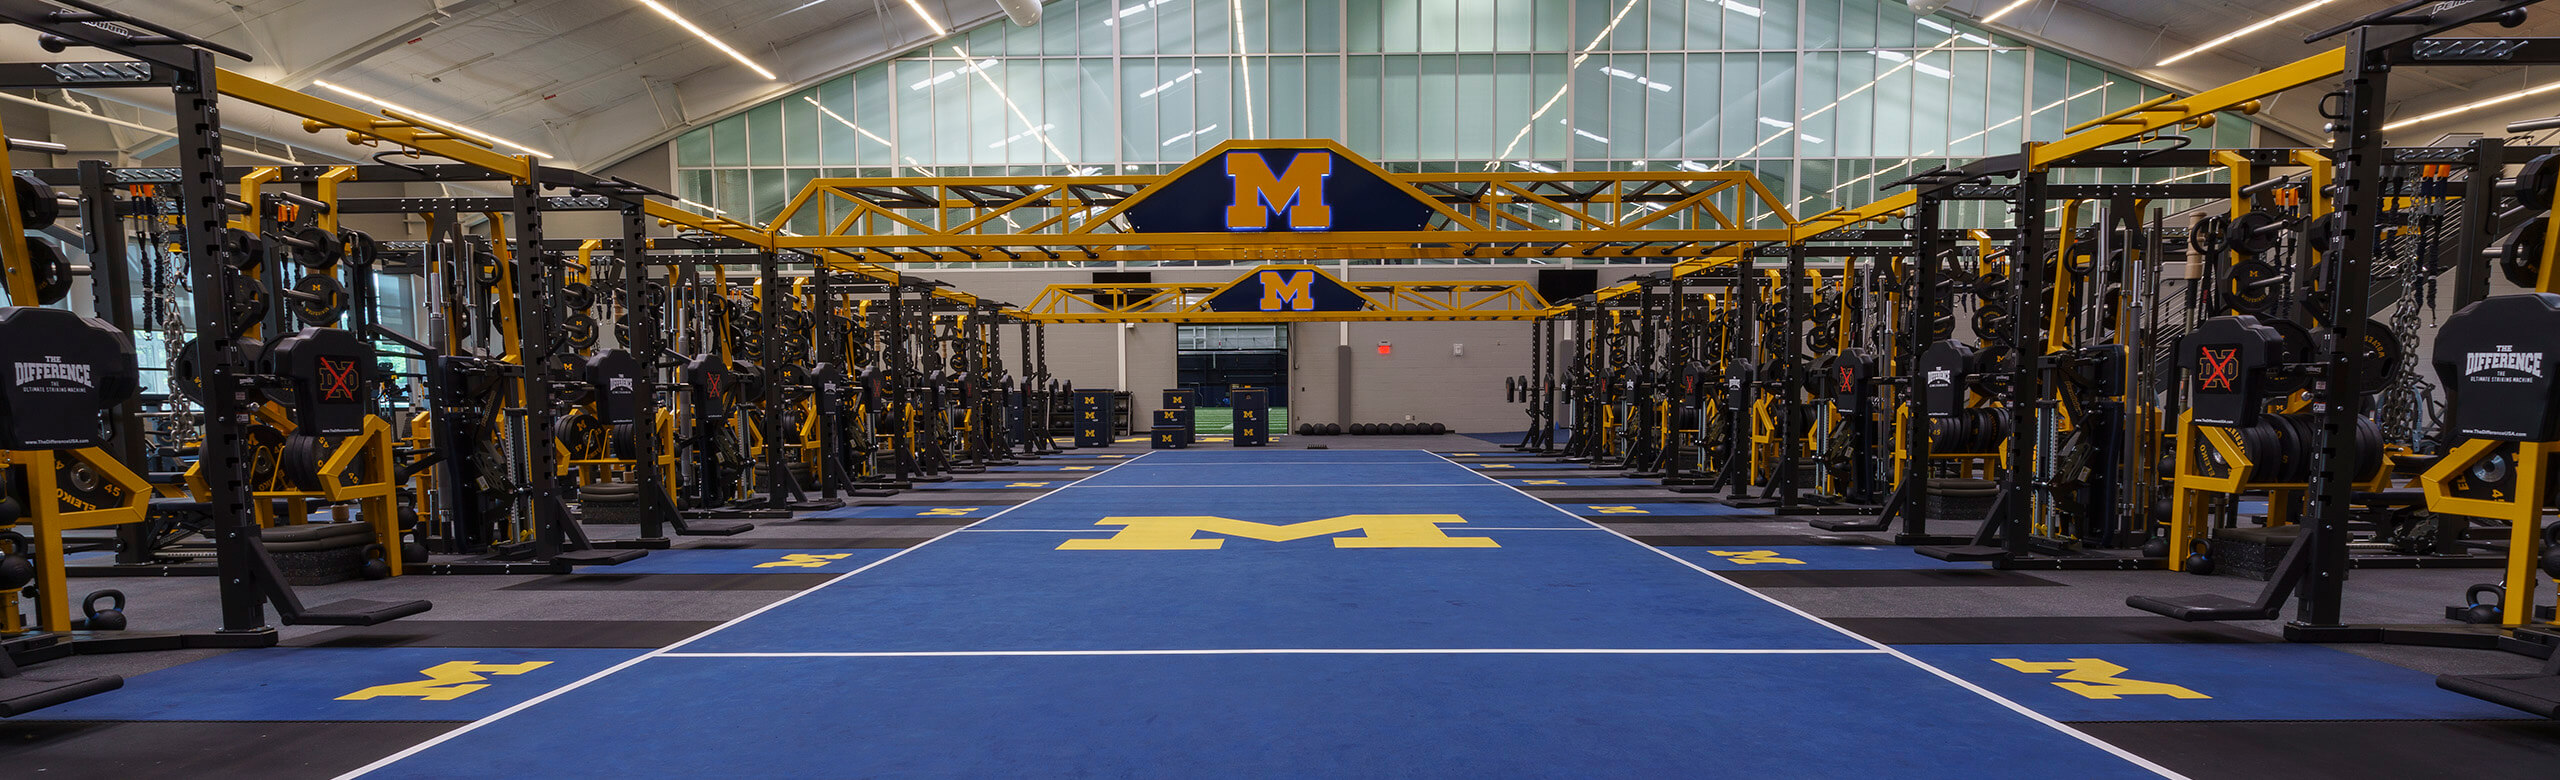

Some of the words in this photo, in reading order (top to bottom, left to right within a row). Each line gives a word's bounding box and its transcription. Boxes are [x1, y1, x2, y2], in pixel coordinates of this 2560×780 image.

[1226, 152, 1331, 229] M
[1260, 271, 1313, 310] M
[45, 355, 62, 363] THE
[2465, 352, 2543, 377] DIFFERENCE
[14, 361, 92, 387] DIFFERENCE
[1084, 396, 1096, 405] M
[1172, 396, 1183, 404] M
[1084, 411, 1096, 420] M
[1164, 411, 1175, 419] M
[1243, 410, 1254, 418] M
[1084, 429, 1096, 438] M
[1161, 434, 1173, 443] M
[1243, 428, 1254, 437] M
[2462, 428, 2527, 437] www.TheDifferenceUSA.com
[104, 483, 121, 497] 45
[57, 488, 97, 512] ELEIKO
[1054, 513, 1501, 550] M
[753, 553, 853, 568] M
[1706, 550, 1807, 565] M
[334, 660, 553, 701] M
[1991, 657, 2213, 700] M
